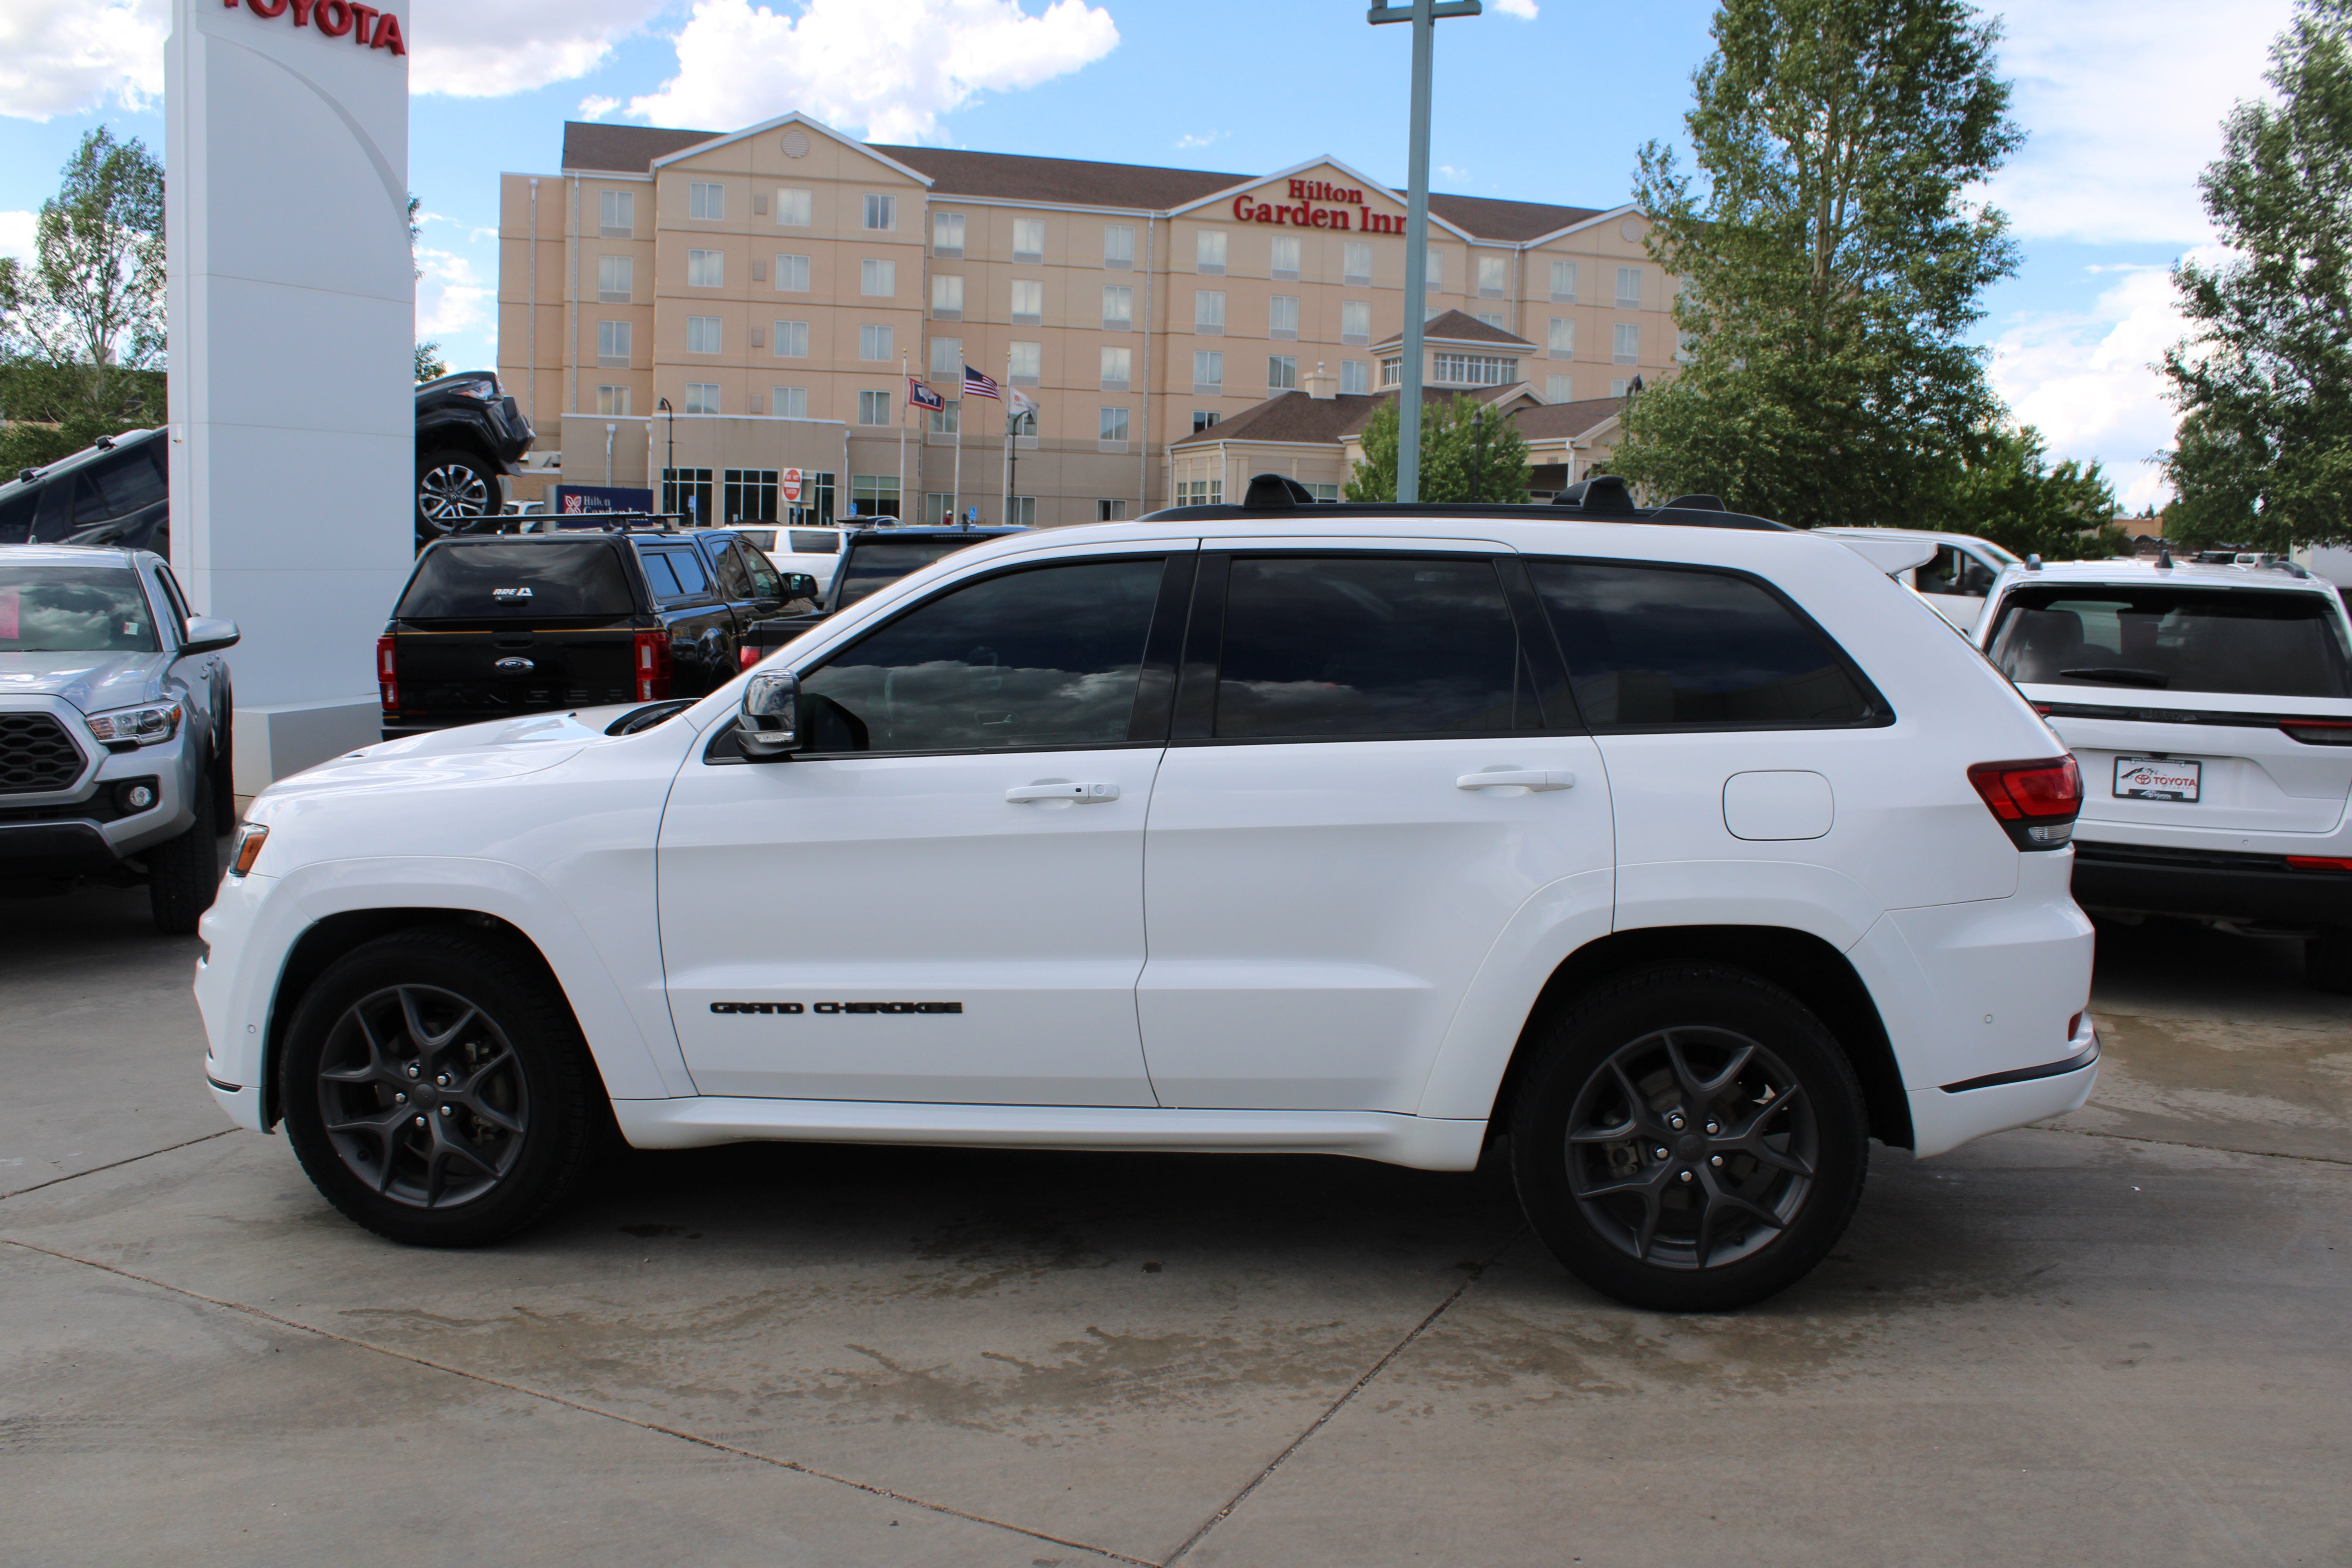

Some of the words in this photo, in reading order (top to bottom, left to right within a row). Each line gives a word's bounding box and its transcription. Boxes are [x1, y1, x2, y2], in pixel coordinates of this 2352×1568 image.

[224, 0, 406, 56] YOTA
[1288, 178, 1363, 204] Hilton
[1233, 194, 1350, 230] Garden
[2153, 777, 2197, 786] TOYOTA
[710, 1002, 804, 1014] GRAND
[813, 1002, 962, 1014] CHEROKEE
